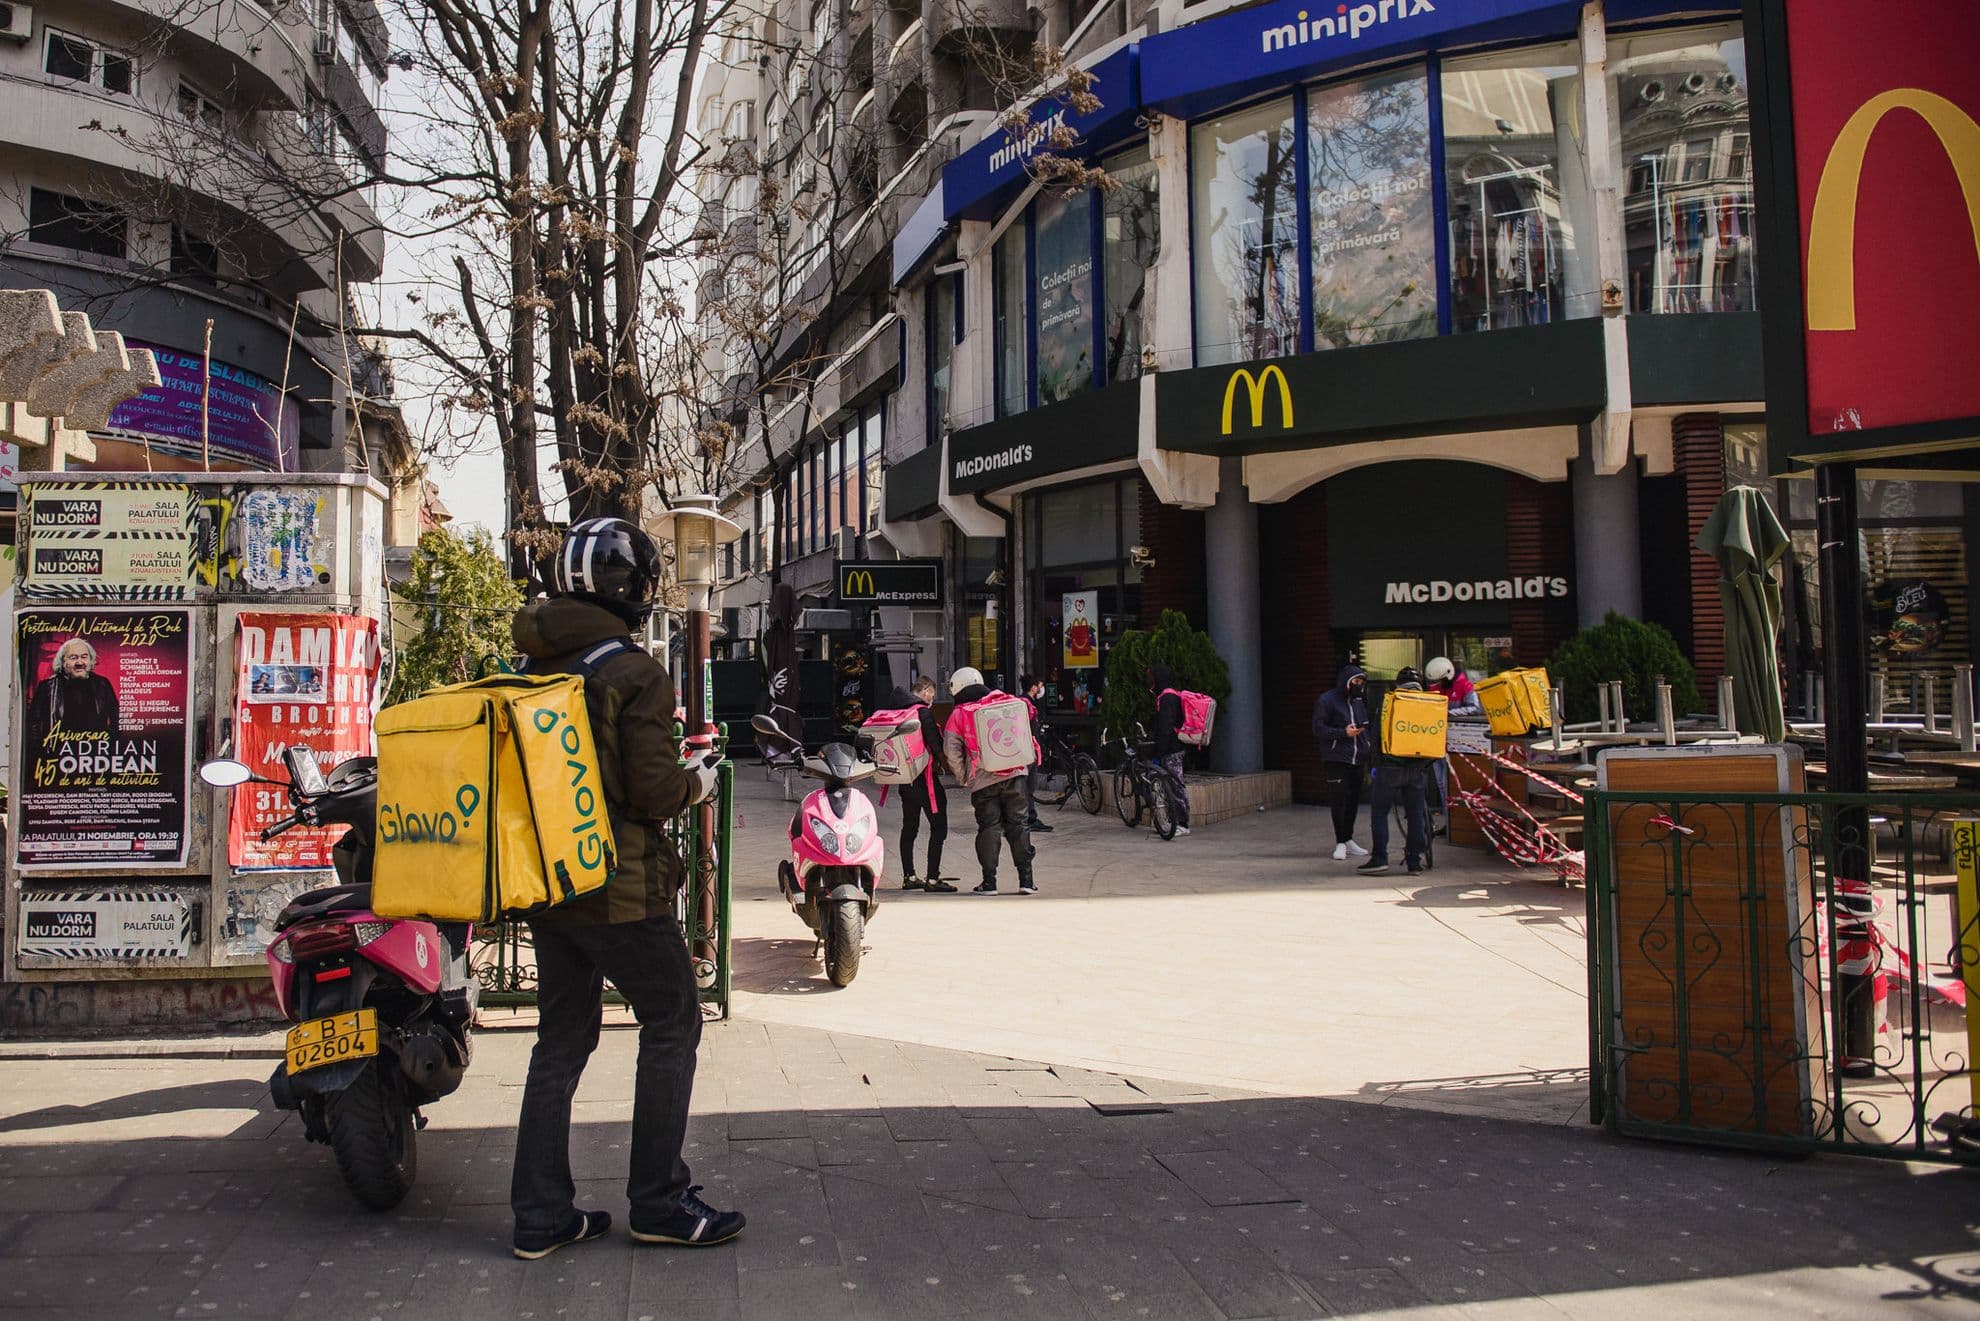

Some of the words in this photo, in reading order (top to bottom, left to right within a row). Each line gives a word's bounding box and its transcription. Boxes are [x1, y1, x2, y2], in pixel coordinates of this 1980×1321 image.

[1318, 218, 1338, 231] de
[1077, 257, 1093, 275] noi
[1042, 299, 1052, 310] de
[178, 357, 201, 371] DE
[955, 444, 1033, 479] McDonald's
[62, 501, 98, 512] VARA
[35, 513, 55, 524] NU
[57, 513, 97, 524] DORM
[128, 510, 180, 518] PALATULUI
[64, 551, 100, 561] VARA
[157, 551, 182, 559] SALA
[38, 562, 57, 573] NU
[59, 562, 99, 573] DORM
[130, 559, 182, 568] PALATULUI
[1385, 576, 1568, 604] McDonald's
[876, 592, 938, 601] McExpress
[119, 633, 157, 647] 2020
[241, 707, 253, 723] &
[1395, 719, 1438, 735] Glovo
[59, 740, 157, 755] ADRIAN
[59, 756, 157, 774] ORDEAN
[561, 724, 603, 870] Glovo
[379, 803, 457, 843] Glovo
[87, 832, 137, 841] NOIEMBRIE,
[138, 832, 157, 840] ORA
[158, 832, 179, 840] 19:30
[57, 913, 93, 925] VARA
[150, 913, 175, 922] SALA
[29, 926, 49, 937] NU
[51, 926, 93, 937] DORM
[123, 922, 175, 931] PALATULUI
[321, 1019, 336, 1039] B
